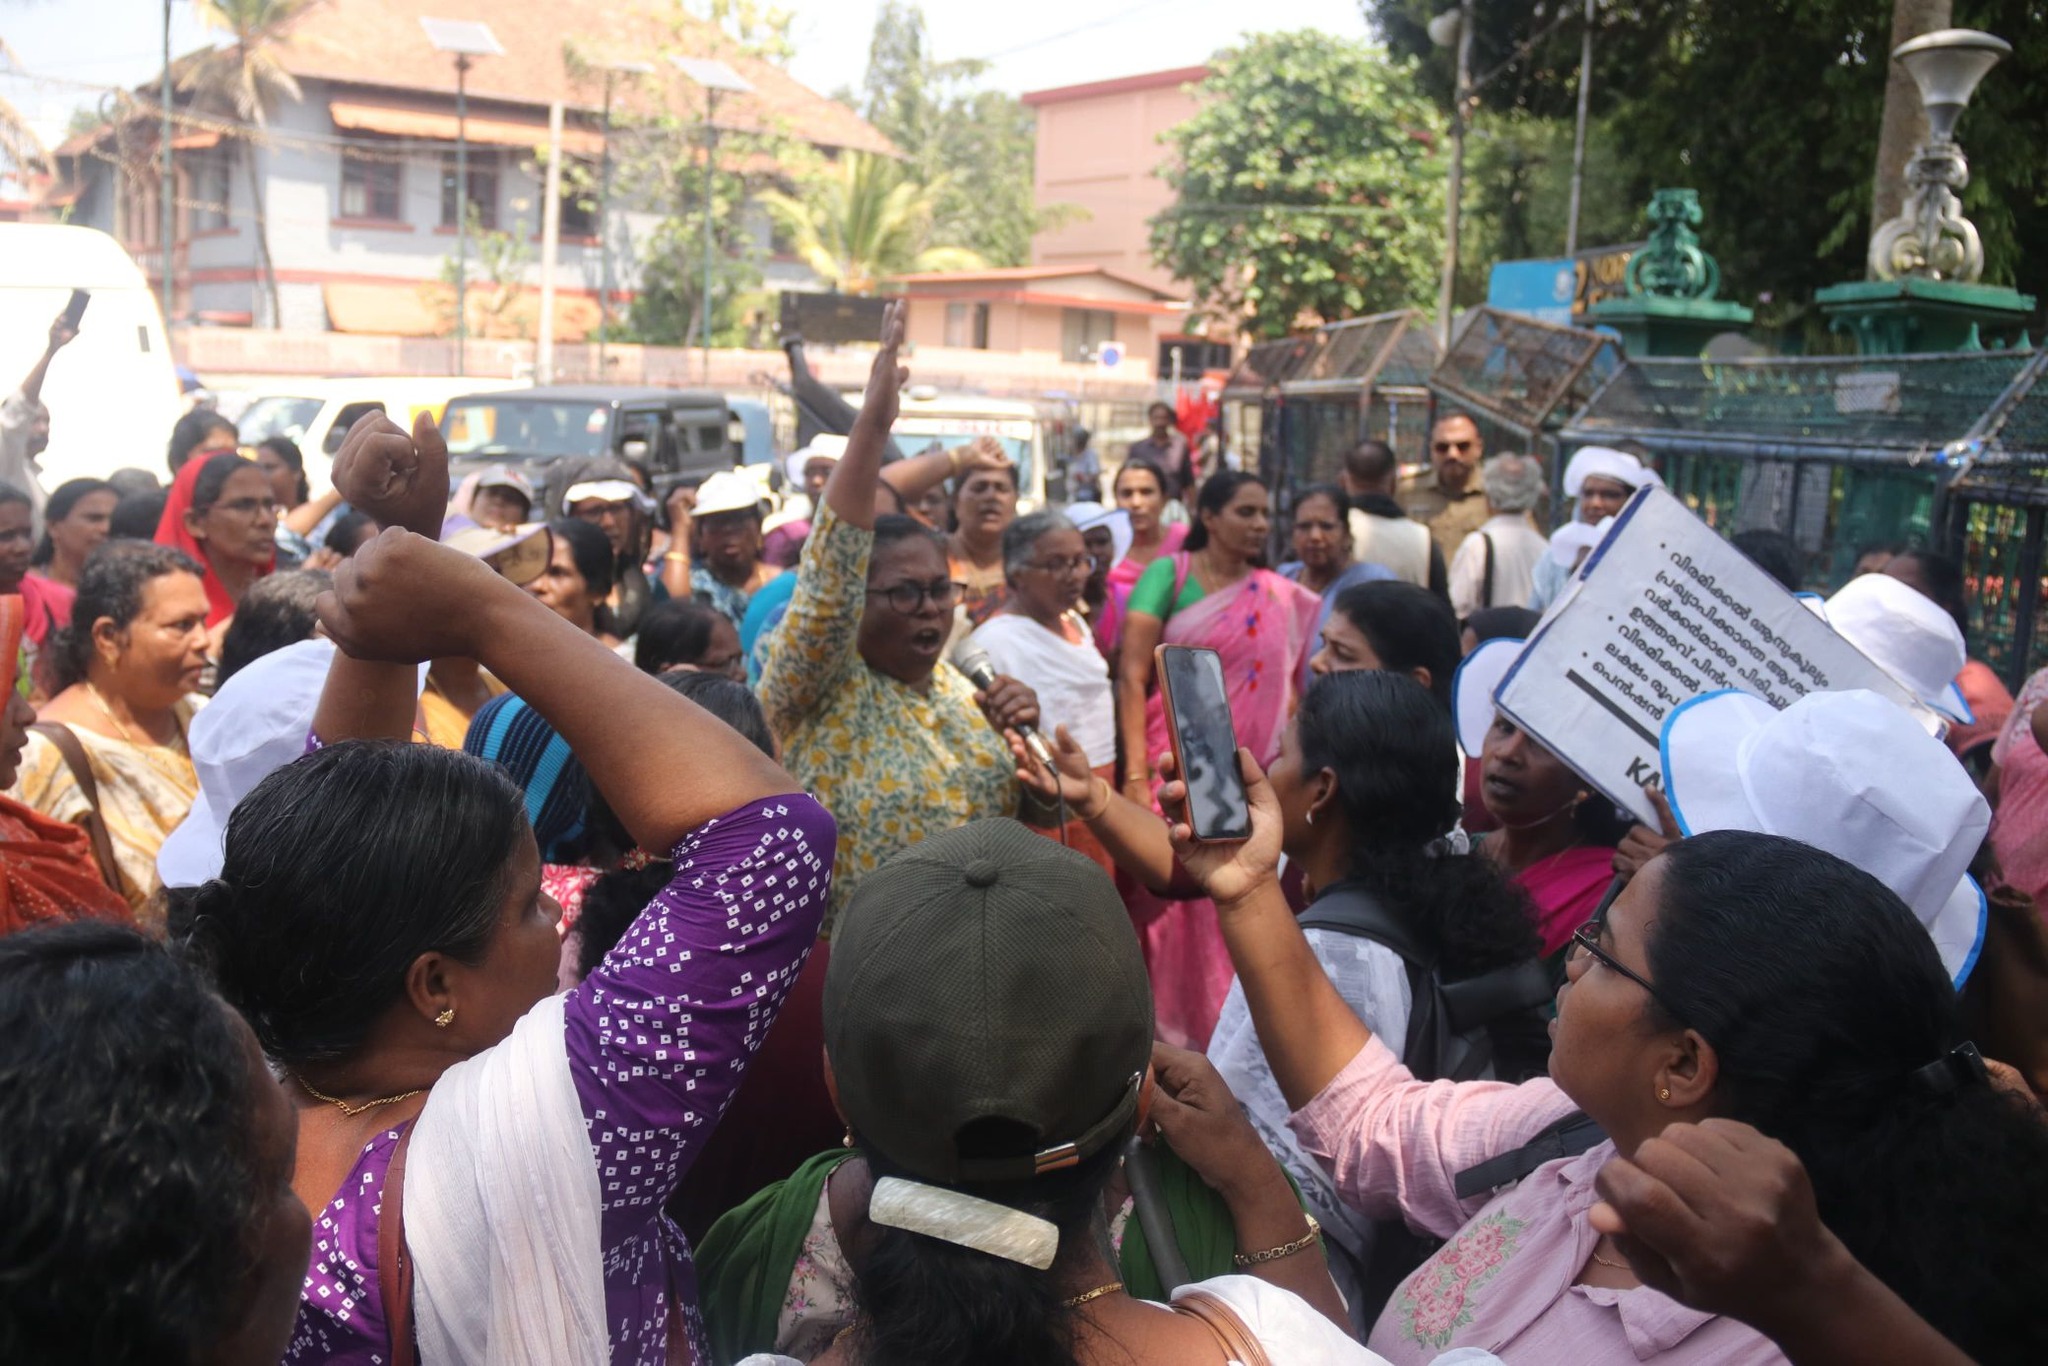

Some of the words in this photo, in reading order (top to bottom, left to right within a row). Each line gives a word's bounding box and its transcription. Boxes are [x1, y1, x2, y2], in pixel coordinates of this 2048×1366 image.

[1670, 553, 1752, 621] വിരമിക്കൽ
[1618, 625, 1701, 693] വിരമിക്കൽ
[1629, 607, 1696, 659] ഉത്തരവ്
[1605, 643, 1648, 682] ലക്ഷം
[1593, 662, 1665, 721] പെൻഷൻ
[1737, 668, 1791, 711] പിരിച്ചു
[1625, 756, 1666, 795] KA
